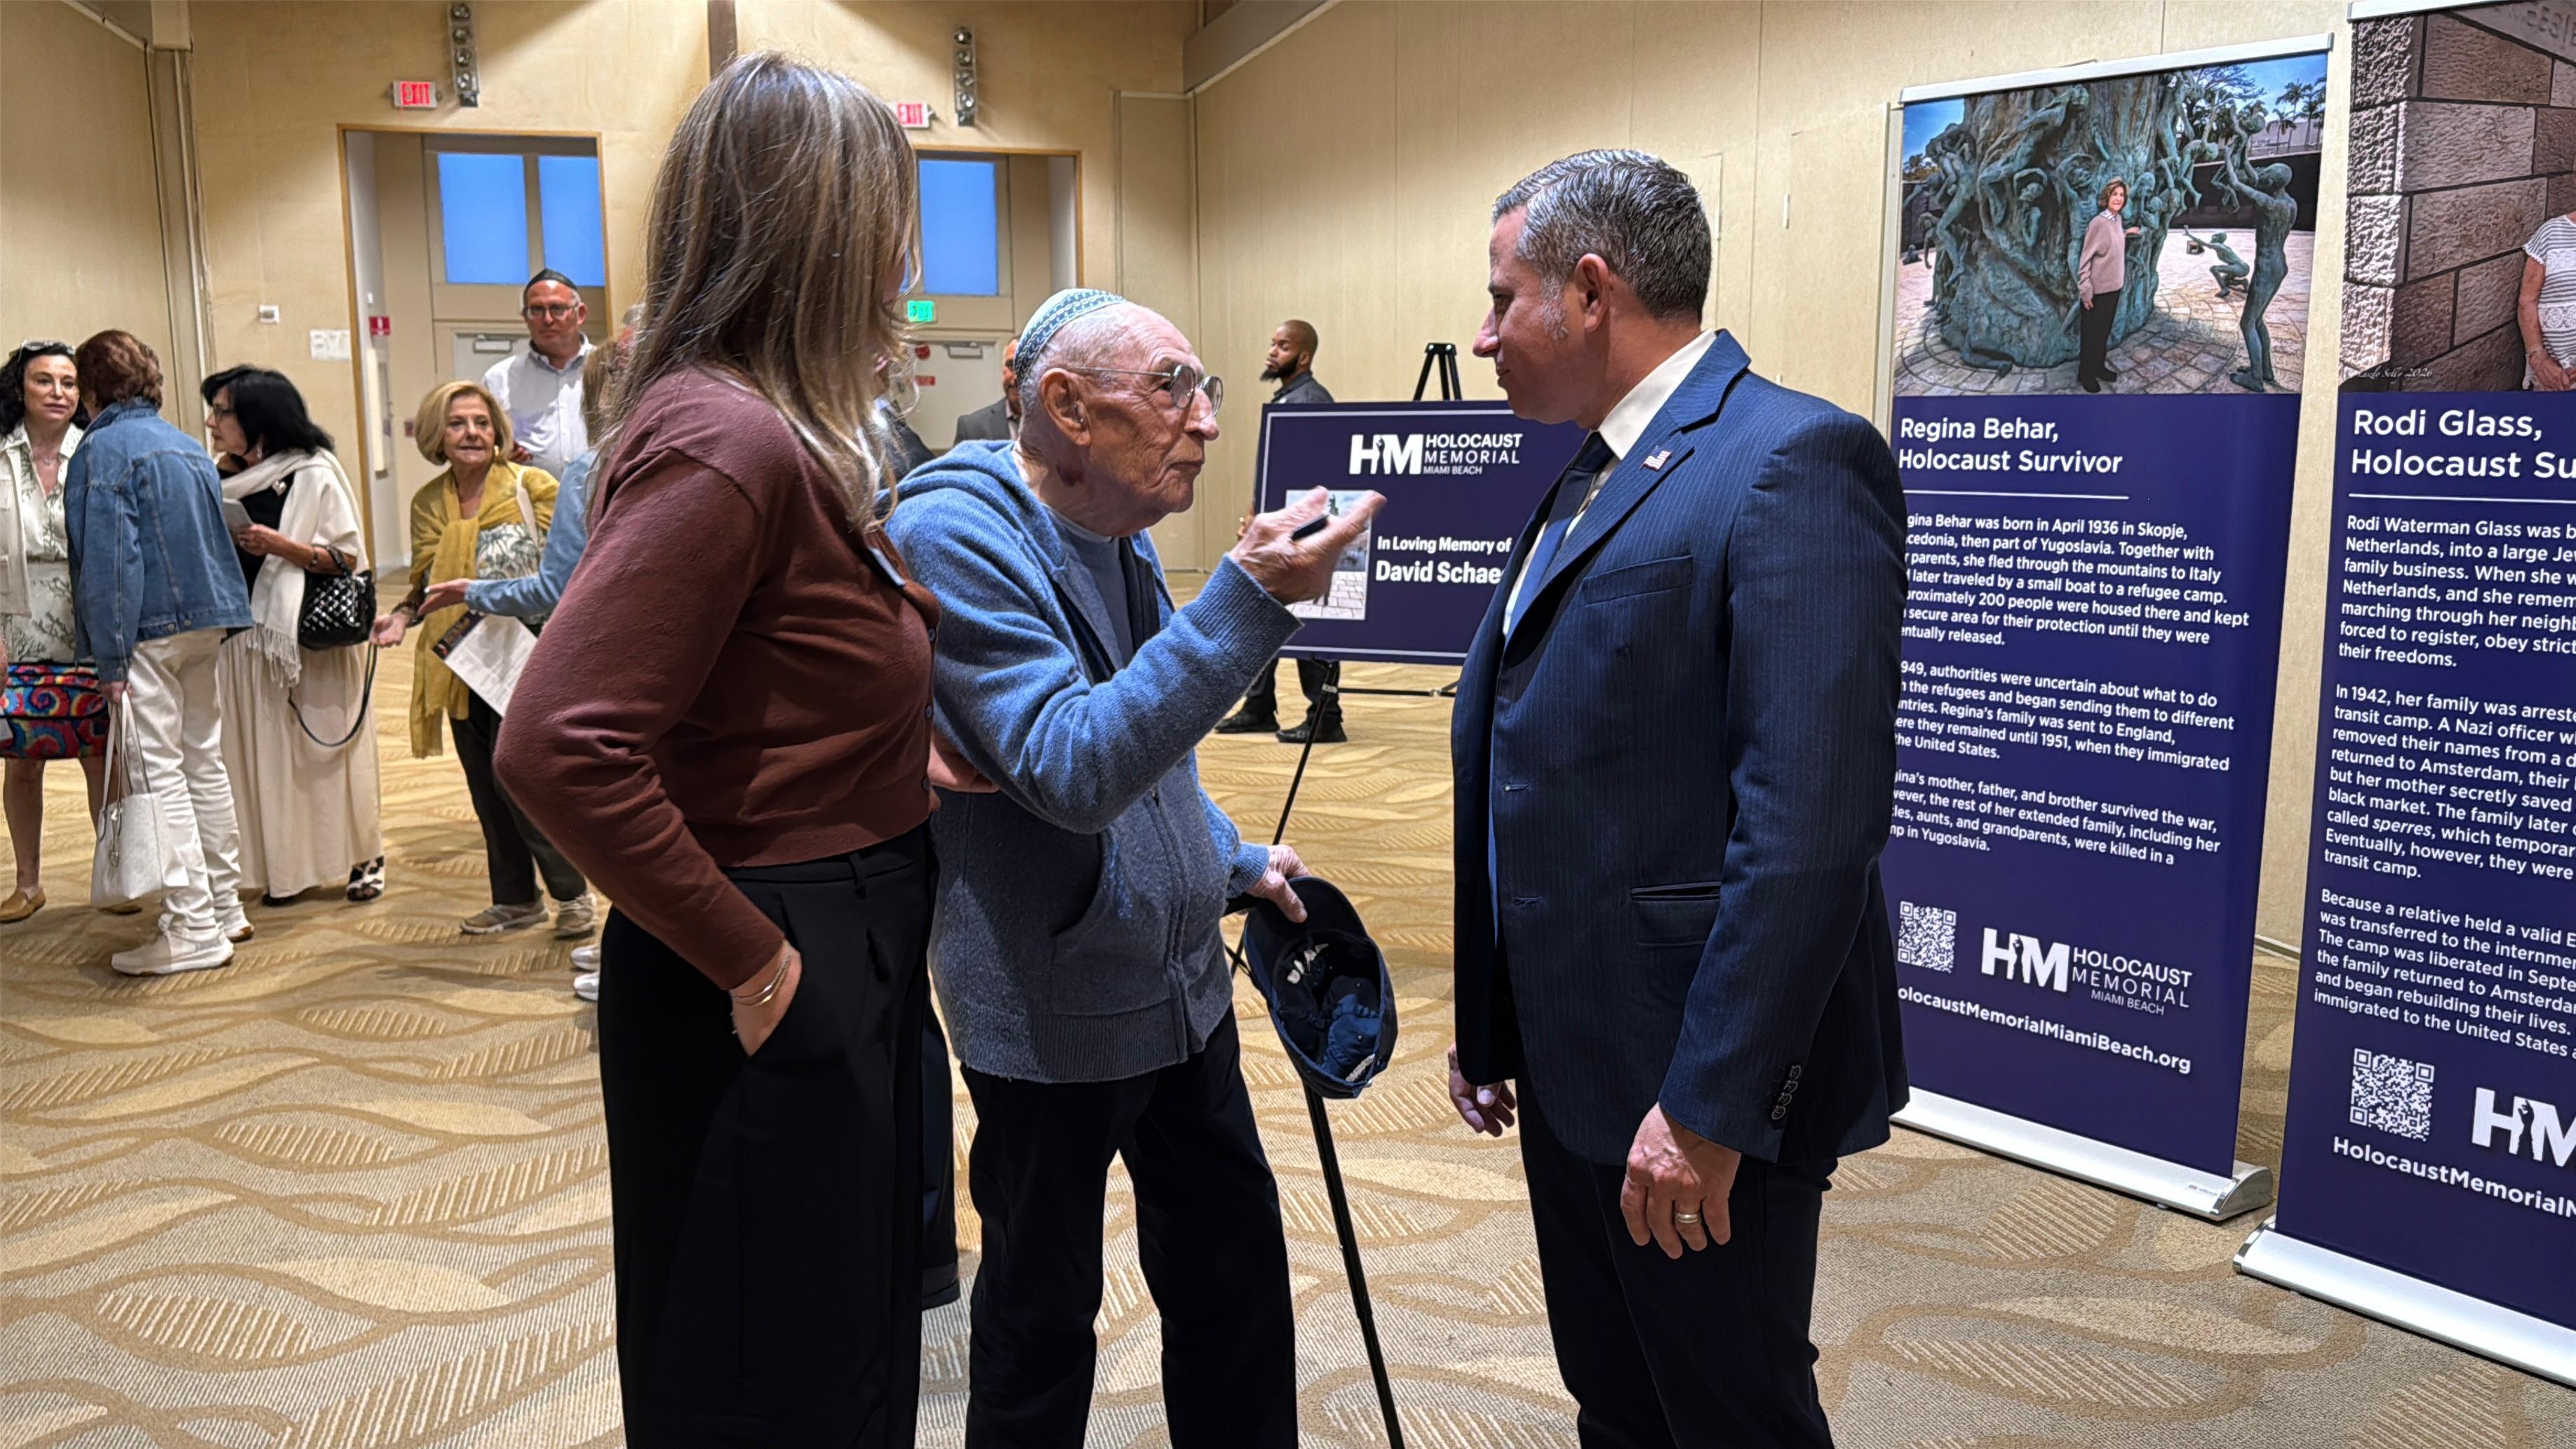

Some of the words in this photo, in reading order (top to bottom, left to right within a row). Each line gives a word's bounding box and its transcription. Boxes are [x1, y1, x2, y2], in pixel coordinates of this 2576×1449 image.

[1426, 433, 1522, 448] HOLOCAUST
[1900, 417, 1975, 443] Regina
[1983, 416, 2058, 443] Behar,
[2354, 409, 2427, 436] Rodi
[2439, 409, 2542, 441] Glass,
[1423, 466, 1450, 474] MIAMI
[1452, 466, 1482, 474] BEACH
[1425, 450, 1520, 464] MEMORIAL
[1898, 447, 2011, 471] Holocaust
[2018, 449, 2123, 473] Survivor
[2352, 448, 2521, 478] Holocaust
[1907, 512, 1933, 528] gina
[1935, 513, 1973, 528] Behar
[1974, 518, 2000, 530] was
[2002, 515, 2034, 531] born
[2036, 517, 2049, 532] in
[2051, 518, 2085, 534] April
[2088, 519, 2119, 535] 1936
[2121, 520, 2135, 535] in
[2137, 521, 2187, 540] Skopje,
[2347, 514, 2380, 531] Rodi
[2384, 516, 2470, 535] Waterman
[2474, 520, 2521, 537] Glass
[2526, 525, 2561, 539] was
[1378, 536, 1390, 550] In
[1393, 537, 1437, 553] Loving
[1439, 537, 1495, 555] Memory
[1496, 537, 1512, 552] of
[1905, 532, 1958, 548] cedonia,
[1961, 533, 1990, 548] then
[1992, 537, 2020, 551] part
[2022, 537, 2038, 551] of
[2039, 537, 2115, 555] Yugoslavia.
[2118, 541, 2180, 559] Together
[2182, 545, 2214, 560] with
[1376, 560, 1433, 582] David
[1437, 562, 1505, 584] Schae
[2344, 557, 2389, 577] family
[2392, 560, 2469, 579] business.
[2474, 565, 2525, 582] When
[2530, 567, 2561, 584] she
[1912, 568, 1940, 583] later
[1943, 571, 1994, 587] traveled
[1997, 573, 2014, 591] by
[2015, 577, 2025, 589] a
[2027, 577, 2062, 591] small
[2065, 577, 2096, 594] boat
[2098, 581, 2114, 595] to
[2115, 584, 2124, 595] a
[2127, 583, 2180, 601] refugee
[2182, 589, 2227, 605] camp.
[1947, 628, 2005, 645] released.
[2340, 620, 2386, 640] forced
[2389, 626, 2407, 641] to
[2410, 628, 2479, 649] register,
[2484, 633, 2528, 652] obey
[2338, 642, 2371, 659] their
[2375, 645, 2457, 667] freedoms.
[1900, 660, 1927, 678] 949,
[1929, 664, 1997, 682] authorities
[2000, 673, 2032, 686] were
[2034, 676, 2096, 693] uncertain
[2099, 681, 2140, 699] about
[2142, 686, 2177, 703] what
[2179, 690, 2194, 705] to
[2197, 692, 2218, 707] do
[2335, 683, 2348, 699] In
[2351, 685, 2391, 706] 1942,
[2395, 690, 2423, 707] her
[2427, 693, 2479, 715] family
[2483, 701, 2517, 716] was
[2521, 706, 2576, 722] arreste
[1996, 707, 2036, 727] family
[2039, 715, 2064, 729] was
[2067, 719, 2095, 733] sent
[2098, 720, 2113, 735] to
[2116, 722, 2175, 746] England,
[1914, 735, 1955, 753] United
[1957, 741, 2000, 759] States.
[2331, 748, 2394, 768] returned
[2399, 755, 2415, 771] to
[2419, 757, 2523, 786] Amsterdam,
[2528, 770, 2570, 789] their
[1927, 776, 1975, 795] mother,
[1978, 781, 2018, 801] father,
[2020, 790, 2046, 804] and
[2048, 791, 2098, 811] brother
[2100, 802, 2159, 822] survived
[2161, 810, 2184, 826] the
[2187, 816, 2217, 834] war,
[2328, 786, 2366, 807] black
[2369, 797, 2430, 816] market.
[2435, 802, 2466, 820] The
[2470, 807, 2523, 830] family
[2528, 814, 2568, 834] later
[1907, 824, 1919, 839] in
[1921, 827, 1990, 851] Yugoslavia.
[1916, 811, 1953, 828] aunts,
[1955, 817, 1980, 830] and
[1982, 821, 2071, 849] grandparents,
[2074, 837, 2107, 853] were
[2109, 840, 2147, 860] killed
[2149, 847, 2163, 863] in
[2165, 854, 2174, 865] a
[2326, 827, 2406, 856] Eventually,
[2410, 841, 2483, 868] however,
[2489, 853, 2527, 874] they
[2531, 862, 2573, 879] were
[2324, 848, 2369, 870] transit
[2373, 860, 2421, 879] camp.
[2321, 888, 2382, 913] Because
[2384, 903, 2394, 915] a
[2399, 905, 2460, 926] relative
[2464, 914, 2502, 934] held
[2505, 924, 2516, 936] a
[2520, 926, 2561, 945] valid
[2073, 946, 2192, 988] HOLOCAUST
[2319, 928, 2343, 947] The
[2347, 938, 2389, 957] camp
[2394, 947, 2424, 963] was
[2429, 950, 2503, 977] liberated
[2508, 964, 2523, 981] in
[2528, 969, 2576, 992] Septe
[2072, 966, 2189, 1008] MEMORIAL
[2091, 989, 2124, 1006] MIAMI
[2126, 997, 2164, 1016] BEACH
[2315, 971, 2341, 988] and
[2344, 975, 2393, 998] began
[2396, 989, 2480, 1018] rebuilding
[2484, 1004, 2525, 1024] their
[2528, 1012, 2570, 1035] lives.
[1898, 986, 2191, 1074] olocaustMemorialMiamiBeach.org
[2314, 988, 2399, 1020] immigrated
[2403, 1009, 2420, 1024] to
[2424, 1013, 2450, 1031] the
[2455, 1018, 2511, 1044] United
[2514, 1032, 2568, 1056] States
